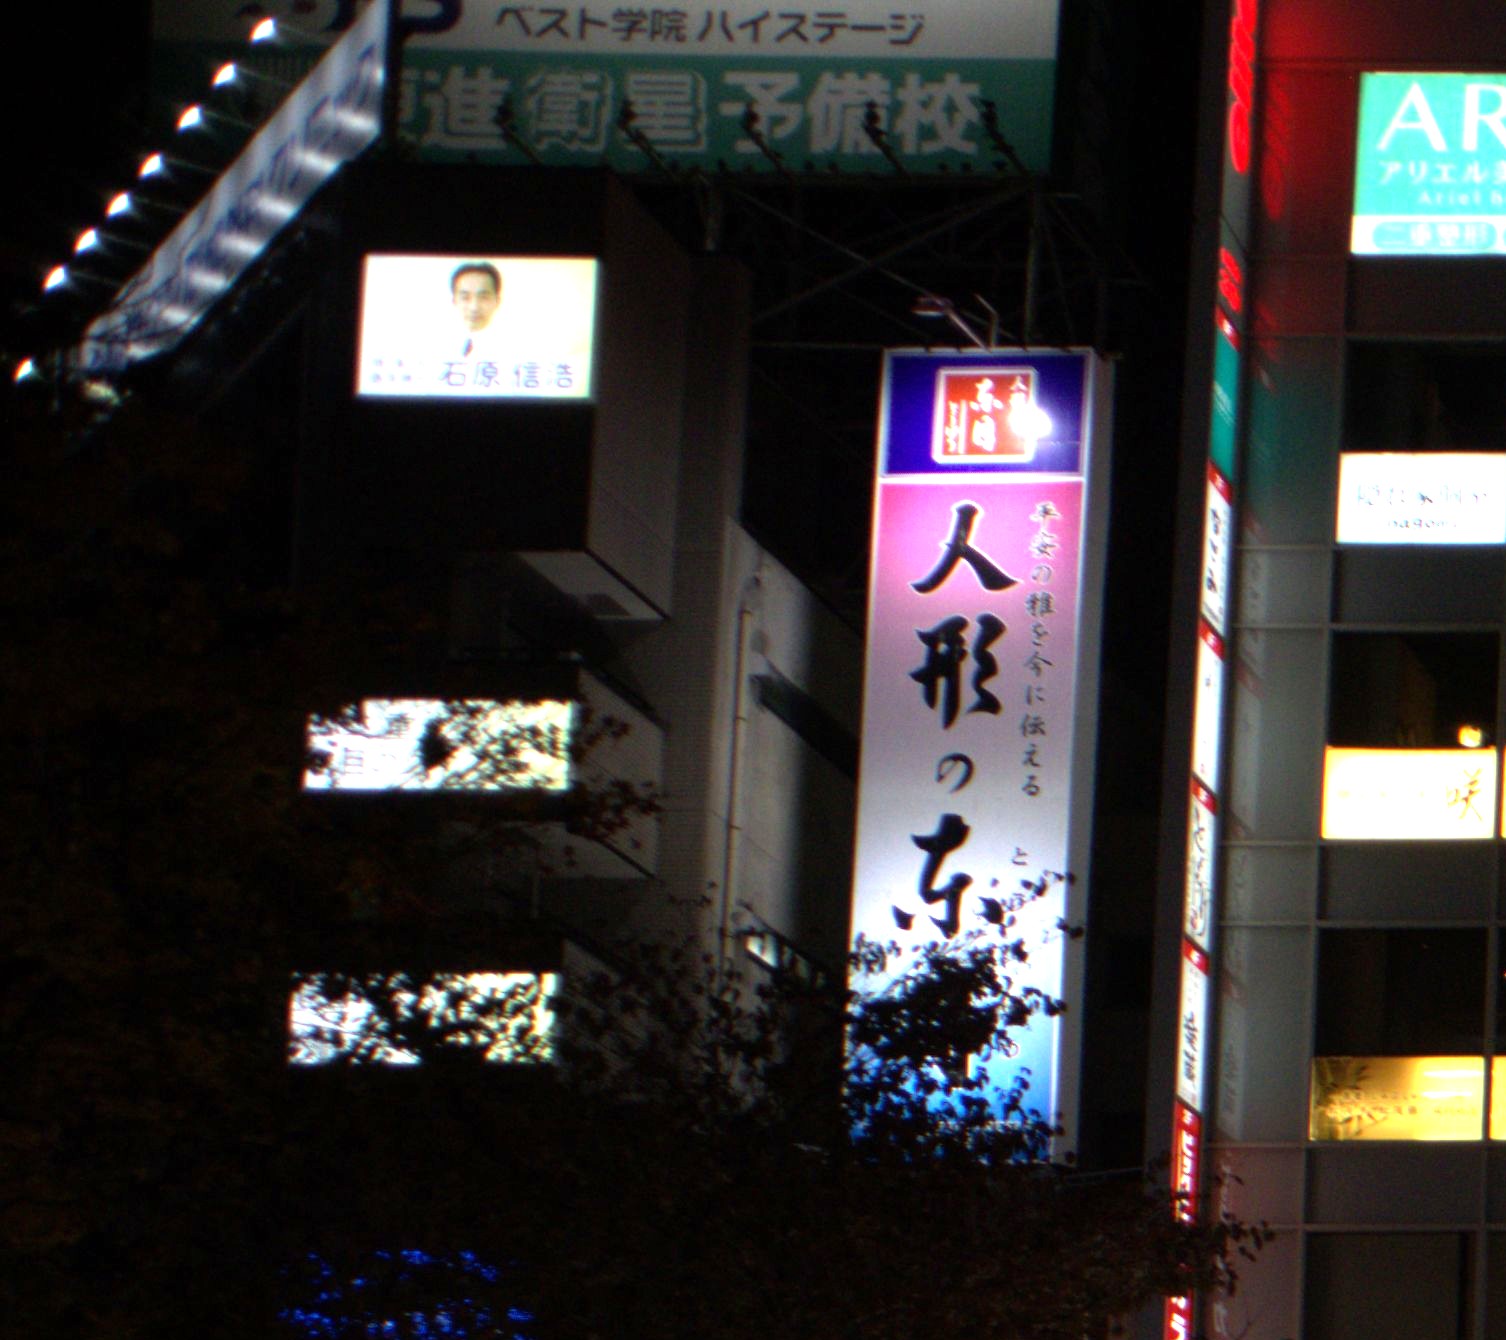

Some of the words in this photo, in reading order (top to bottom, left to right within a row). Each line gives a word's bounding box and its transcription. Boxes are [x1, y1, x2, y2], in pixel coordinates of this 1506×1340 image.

[496, 7, 688, 46] ベスト学院
[700, 9, 926, 46] ハイステージ
